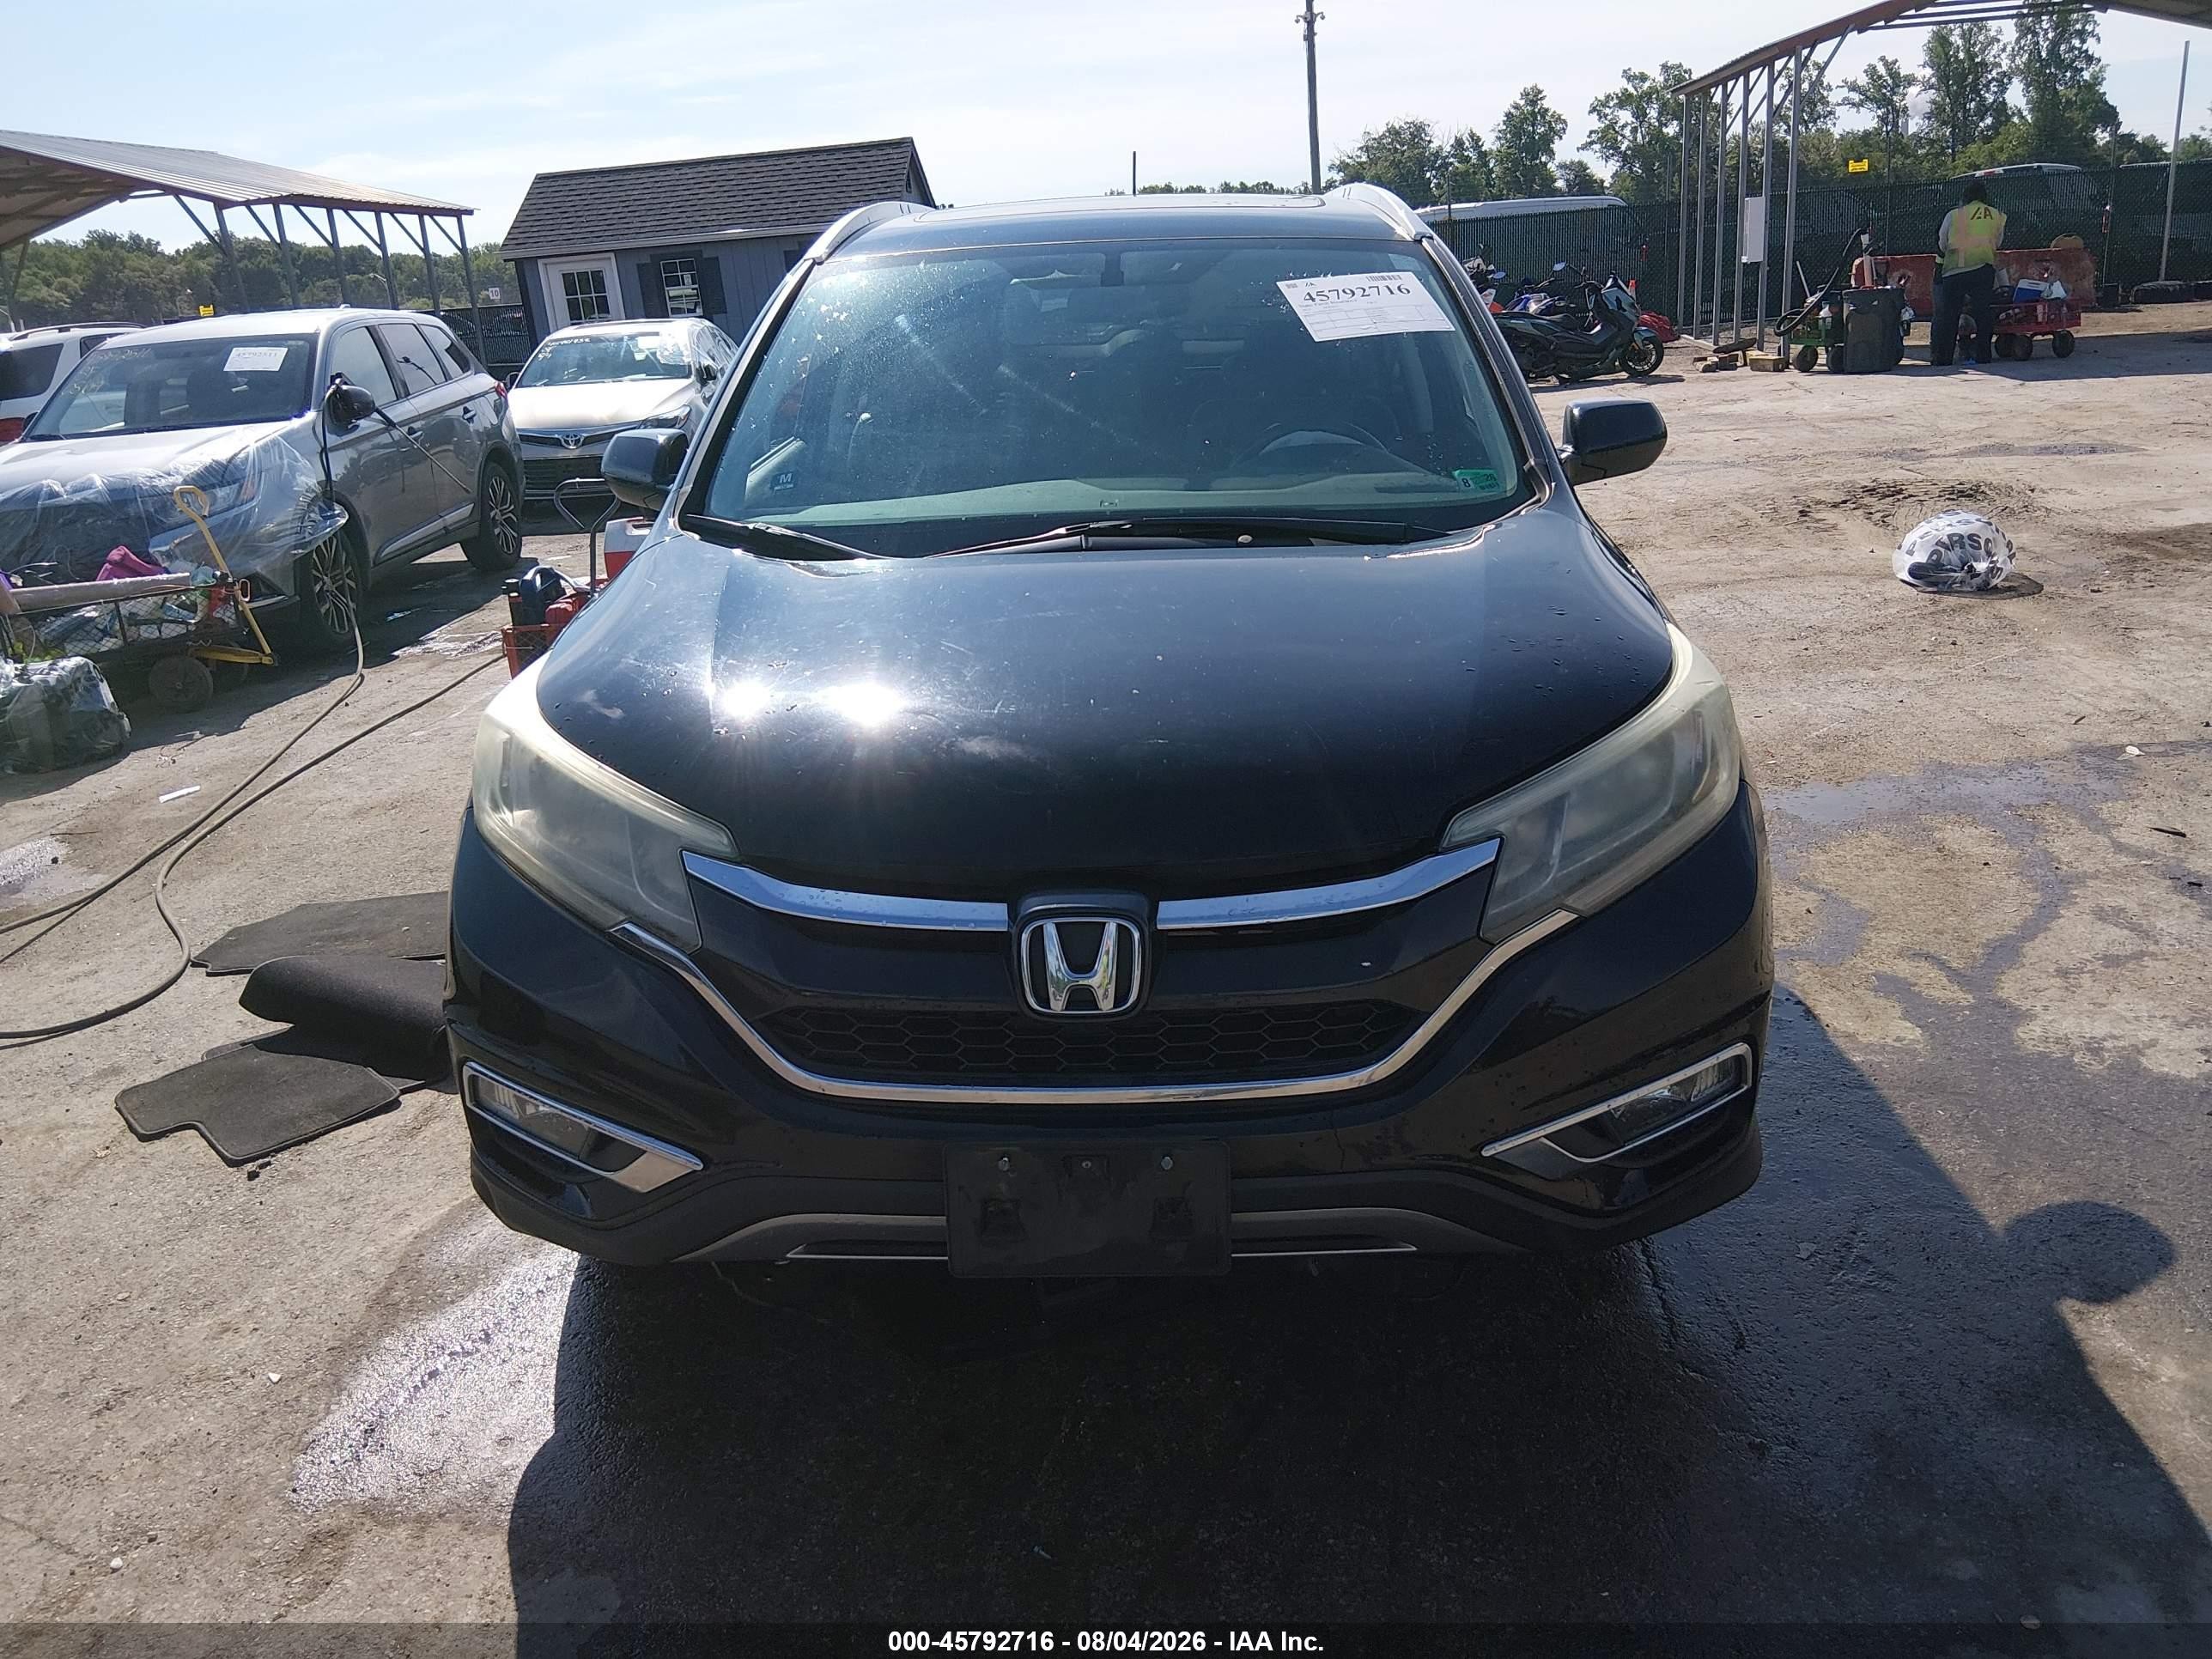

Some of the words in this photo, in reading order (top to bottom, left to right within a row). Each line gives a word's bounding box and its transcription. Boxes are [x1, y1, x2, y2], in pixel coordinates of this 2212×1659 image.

[489, 289, 500, 298] 10
[1303, 284, 1411, 303] 45792716
[1462, 477, 1471, 488] 8
